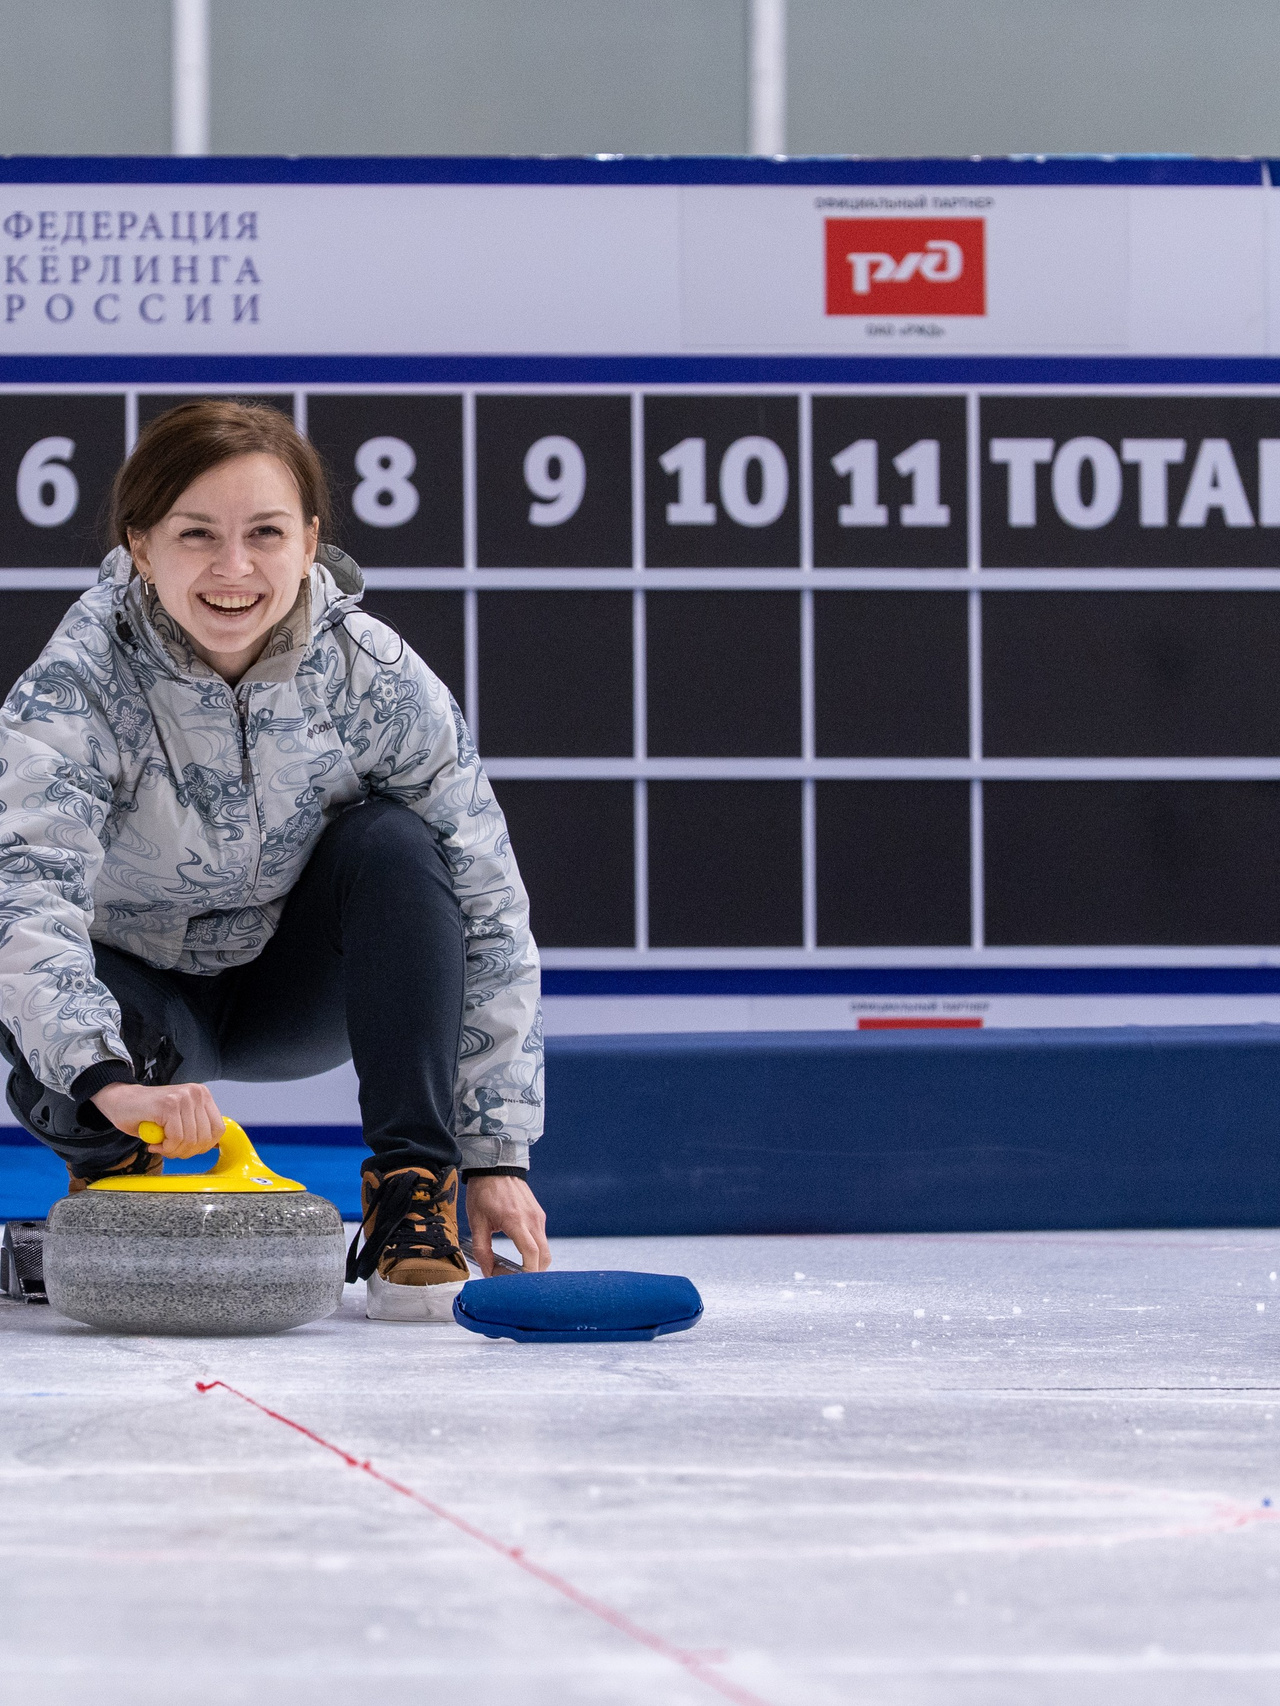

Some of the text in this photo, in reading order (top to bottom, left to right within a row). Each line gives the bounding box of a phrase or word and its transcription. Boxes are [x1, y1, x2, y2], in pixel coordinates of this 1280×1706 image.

[3, 210, 259, 245] ФЕДЕРАЦИЯ
[4, 246, 262, 285] КЁРЛИНГА
[4, 292, 260, 325] РОССИИ
[17, 437, 79, 527] 6
[353, 437, 418, 527] 8
[525, 436, 585, 526] 9
[660, 436, 787, 526] 10
[832, 439, 950, 527] 11
